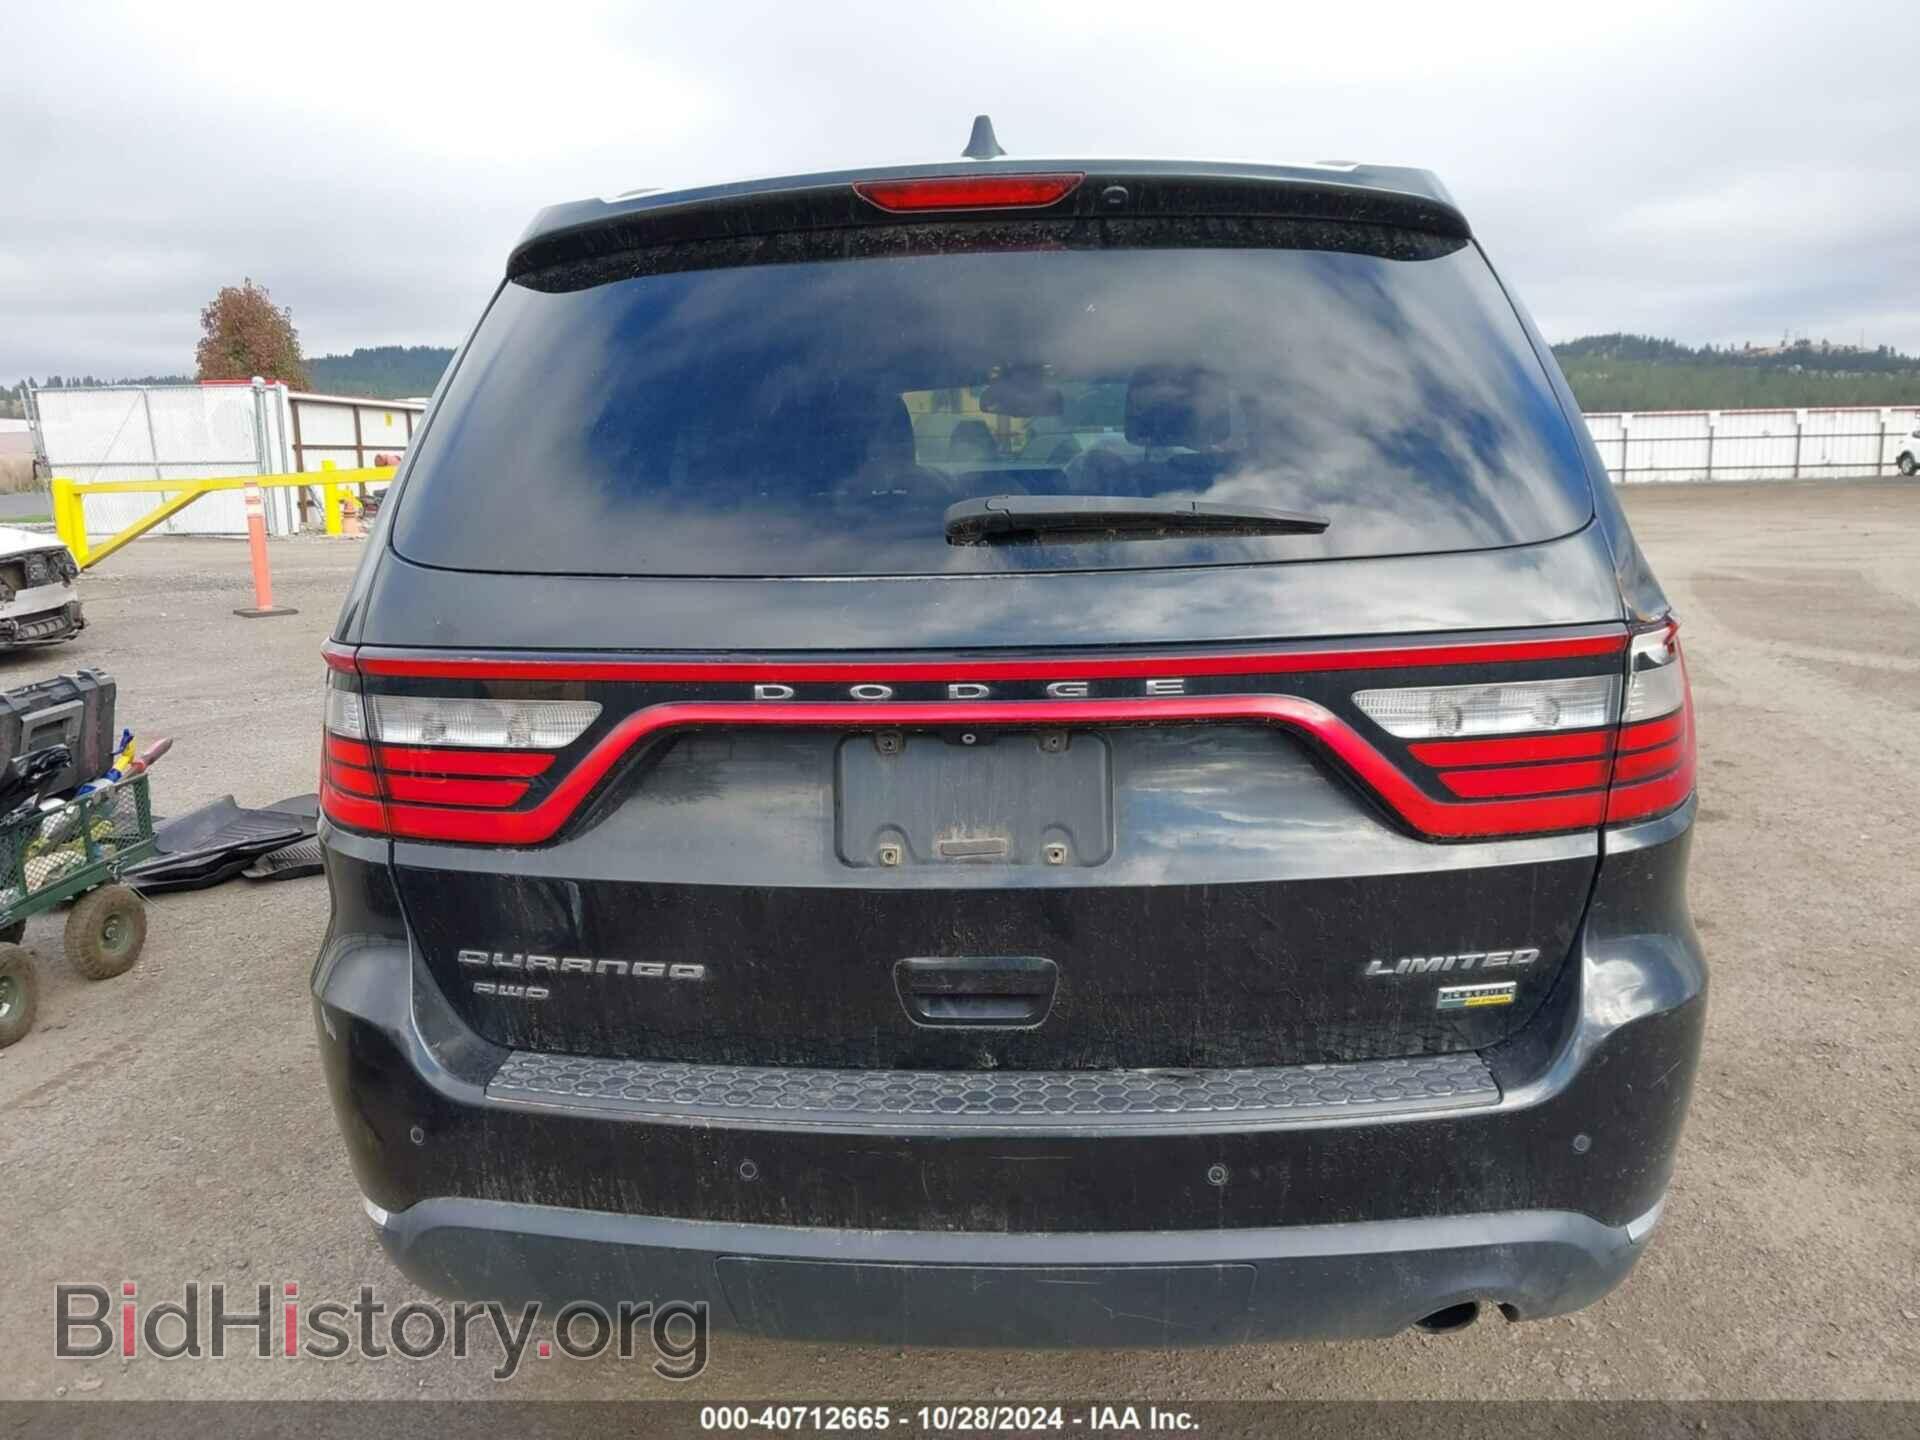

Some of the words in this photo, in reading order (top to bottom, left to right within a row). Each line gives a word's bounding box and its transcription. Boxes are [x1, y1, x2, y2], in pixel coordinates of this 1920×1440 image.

[753, 679, 1185, 700] DODGE
[458, 949, 705, 979] DURANGO
[1366, 948, 1541, 976] LIMITED
[473, 982, 549, 999] AWD
